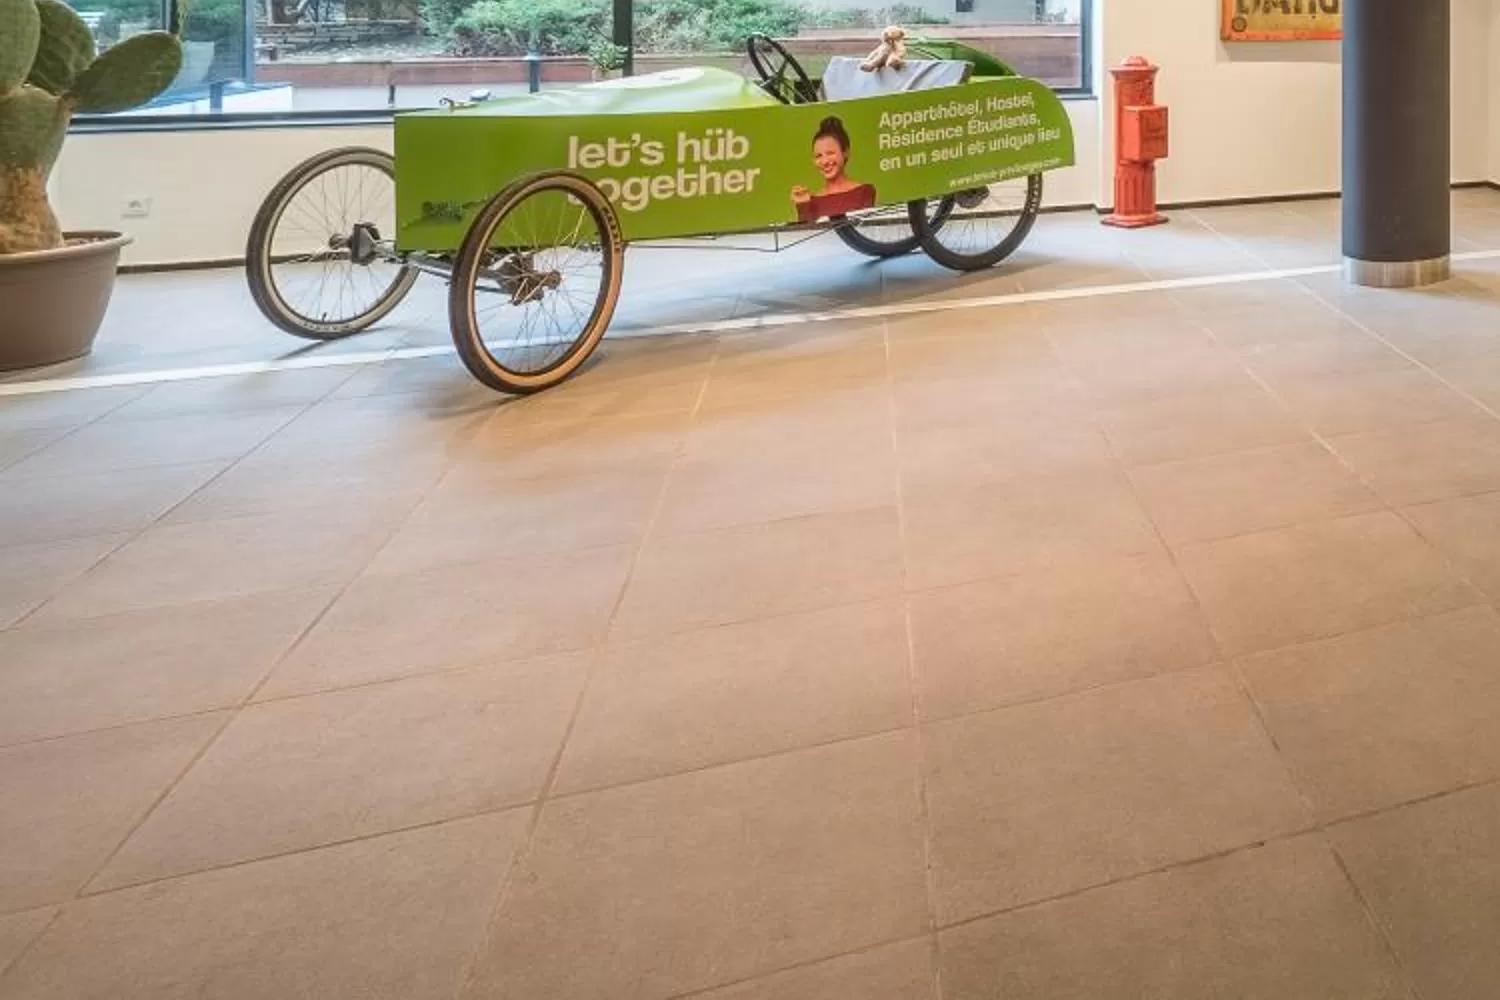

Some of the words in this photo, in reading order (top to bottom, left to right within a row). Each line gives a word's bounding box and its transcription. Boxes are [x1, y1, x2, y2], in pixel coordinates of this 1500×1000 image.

[879, 99, 984, 129] Apparthôtel,
[879, 125, 964, 150] Résidence
[967, 112, 1041, 136] Étudiants,
[676, 128, 749, 163] hüb
[880, 155, 901, 171] en
[906, 149, 927, 167] un
[931, 142, 964, 163] seul
[967, 143, 985, 156] et
[988, 132, 1035, 152] unique
[1037, 127, 1061, 142] lieu
[567, 164, 761, 212] ogether
